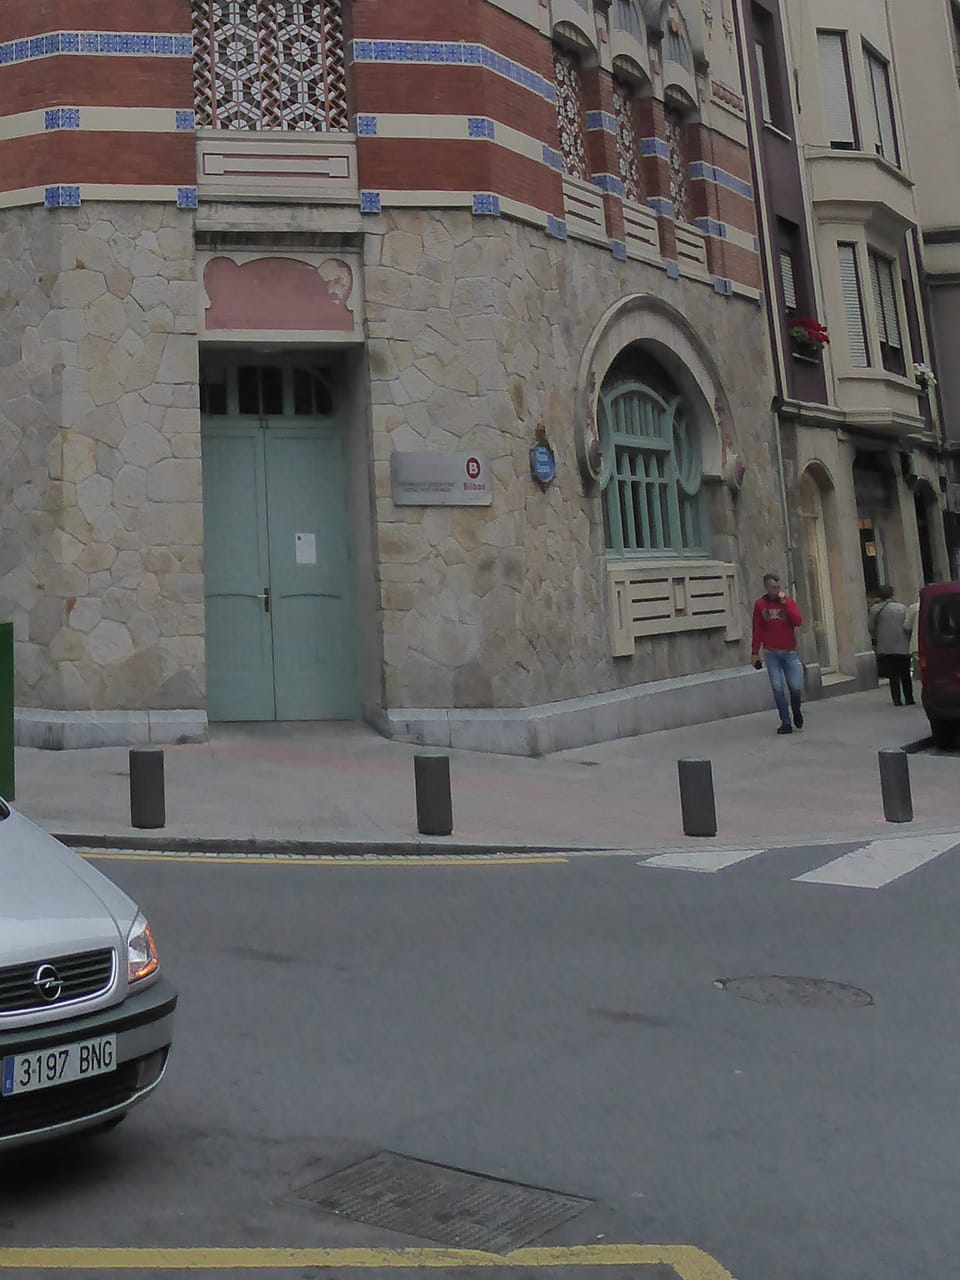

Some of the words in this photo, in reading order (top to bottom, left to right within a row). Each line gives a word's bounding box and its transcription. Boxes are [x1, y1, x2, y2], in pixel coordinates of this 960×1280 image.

[468, 462, 478, 474] B
[19, 1048, 70, 1087] 3197
[79, 1040, 113, 1075] BNG
